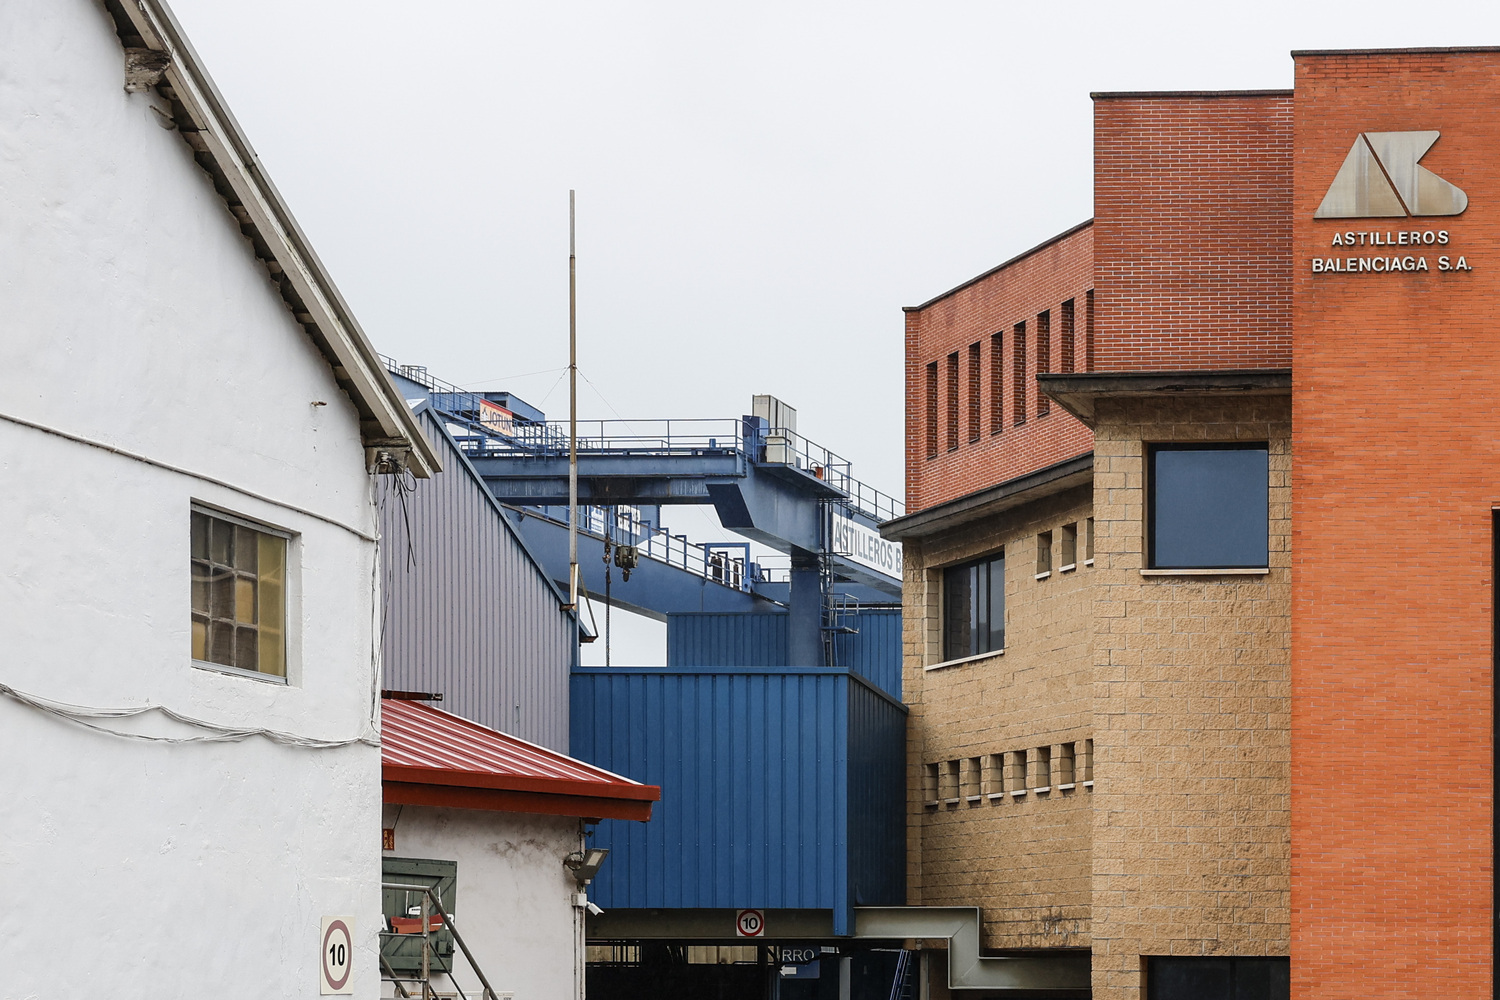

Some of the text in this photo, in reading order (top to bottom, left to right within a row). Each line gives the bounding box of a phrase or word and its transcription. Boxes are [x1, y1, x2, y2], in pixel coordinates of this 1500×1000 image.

[1332, 231, 1449, 246] ASTILLEROS
[1312, 255, 1472, 273] BALENCIAGA S.A.
[489, 410, 512, 432] JOTUN
[834, 521, 893, 570] ASTILLEROS
[743, 917, 758, 929] 10
[329, 943, 345, 966] 10
